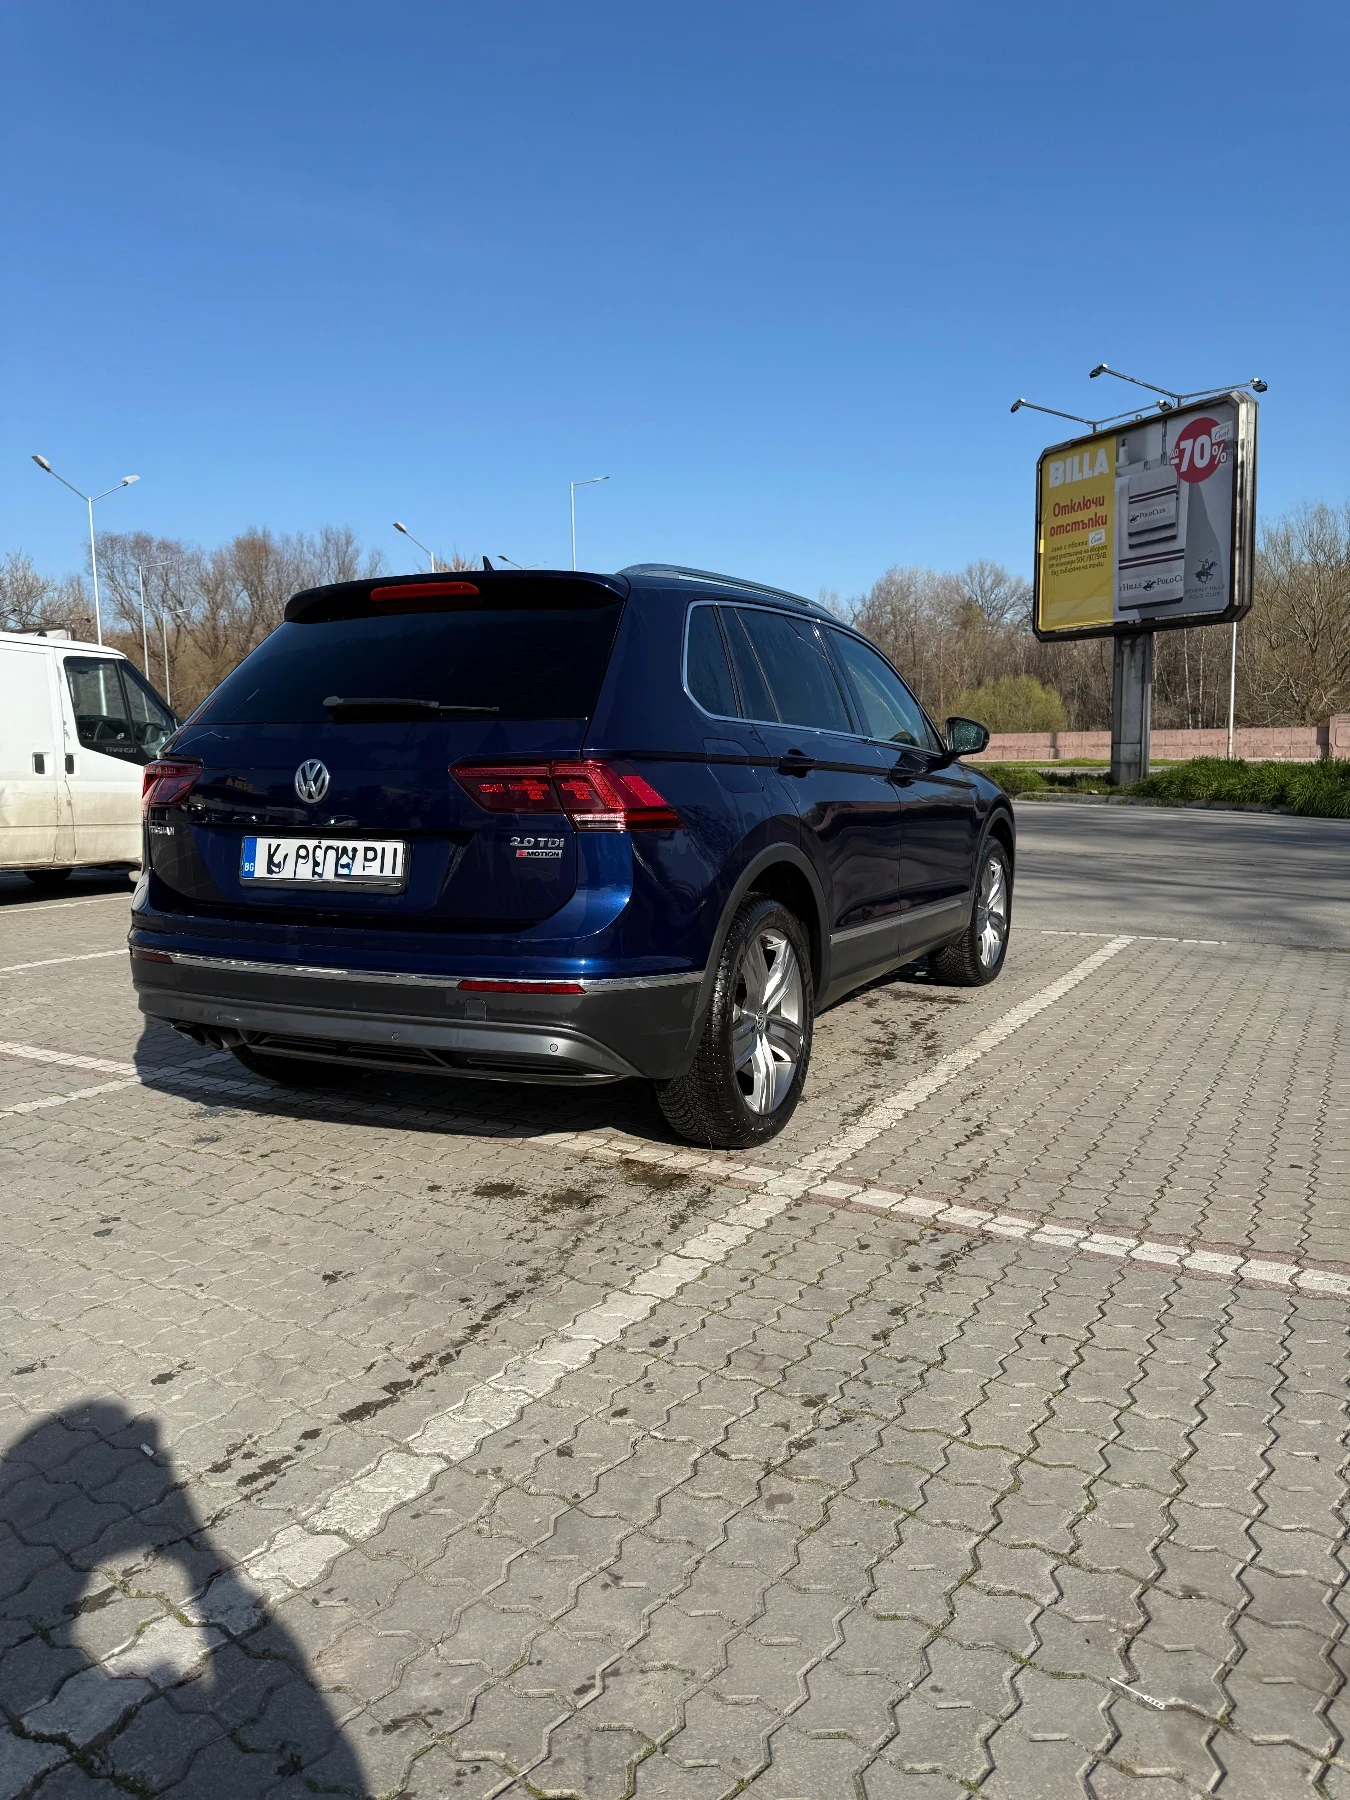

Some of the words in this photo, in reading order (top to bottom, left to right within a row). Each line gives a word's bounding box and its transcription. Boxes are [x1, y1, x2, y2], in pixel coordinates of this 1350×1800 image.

[1049, 448, 1109, 488] BILLA
[1053, 495, 1105, 517] Отключи
[1049, 512, 1108, 537] отстъпки
[105, 746, 138, 754] TRANSIT
[536, 837, 565, 848] TDI
[244, 862, 255, 872] BG
